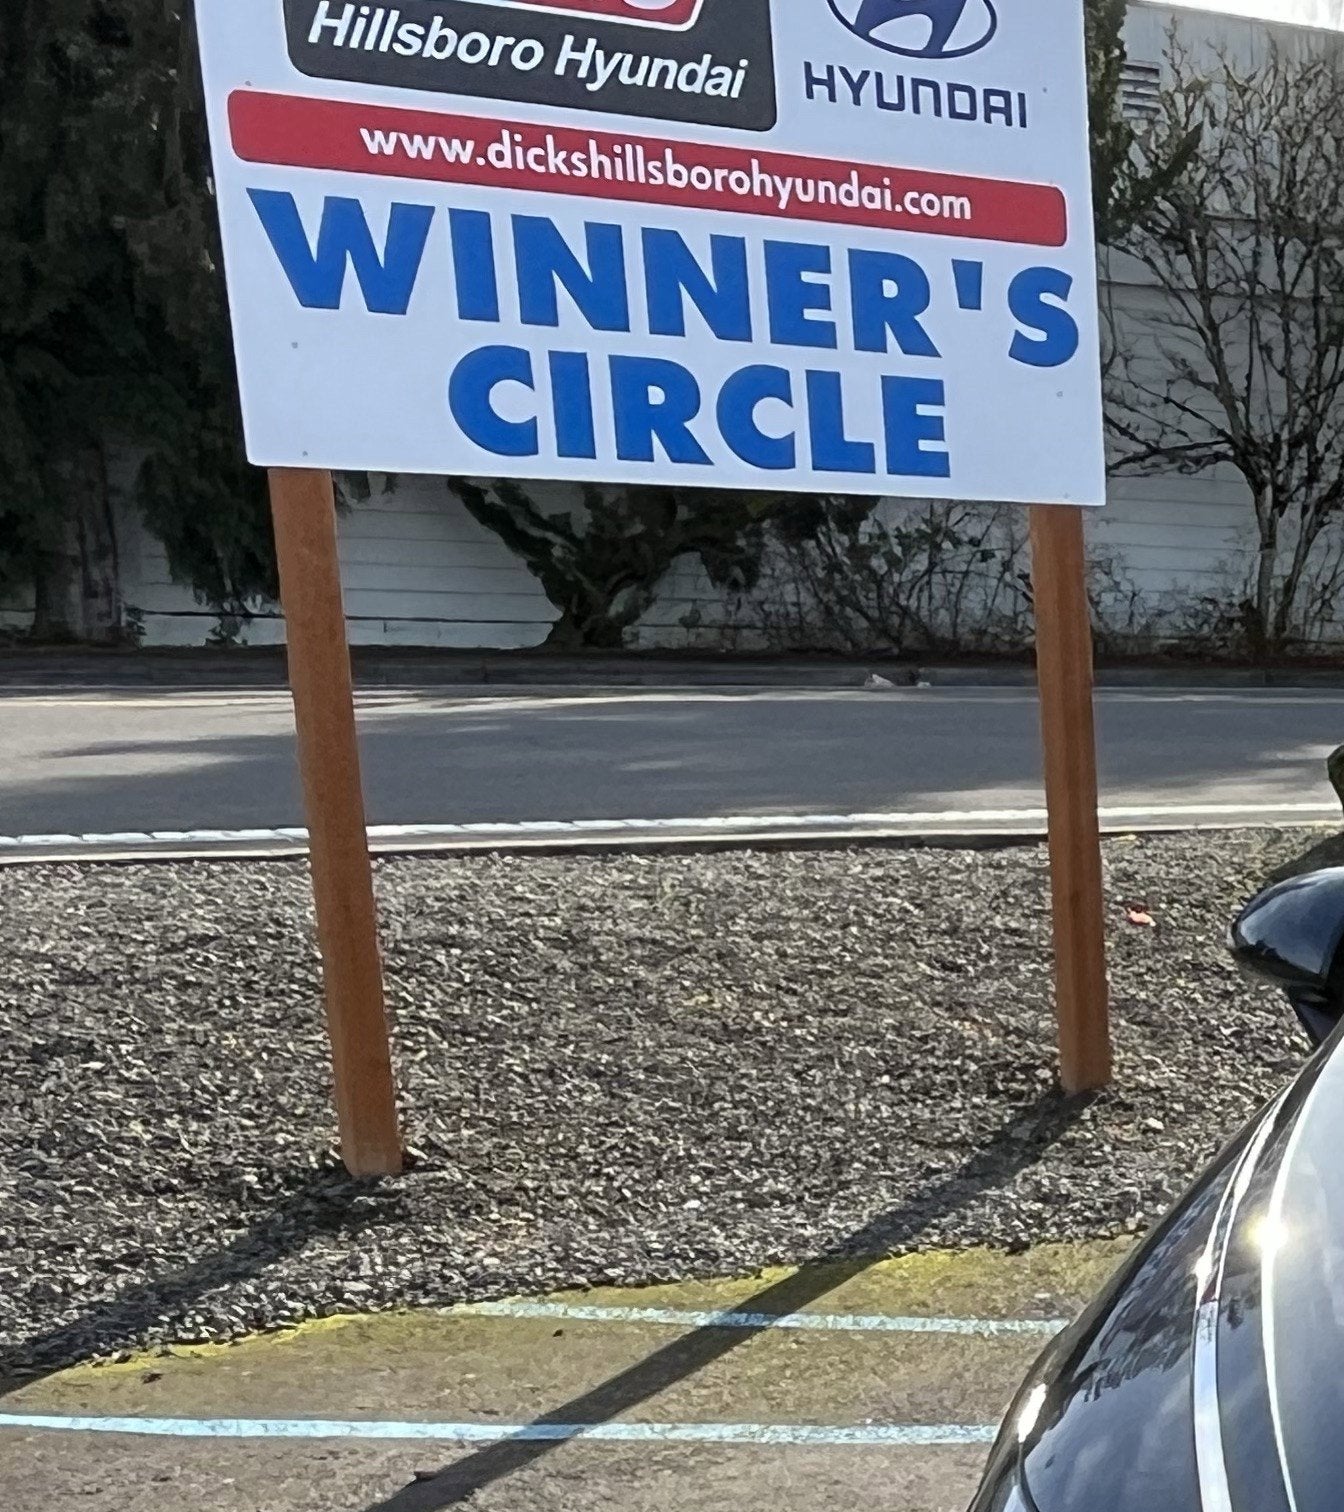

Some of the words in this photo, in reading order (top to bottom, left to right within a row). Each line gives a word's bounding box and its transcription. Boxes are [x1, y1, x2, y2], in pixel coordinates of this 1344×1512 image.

[307, 0, 545, 71] Hillsboro
[554, 34, 749, 99] Hyundai
[803, 61, 1028, 128] HYUNDAI
[359, 123, 972, 221] www.dickshillsborohyundai.com
[246, 187, 1080, 367] WINNER'S
[447, 345, 951, 478] CIRCLE
